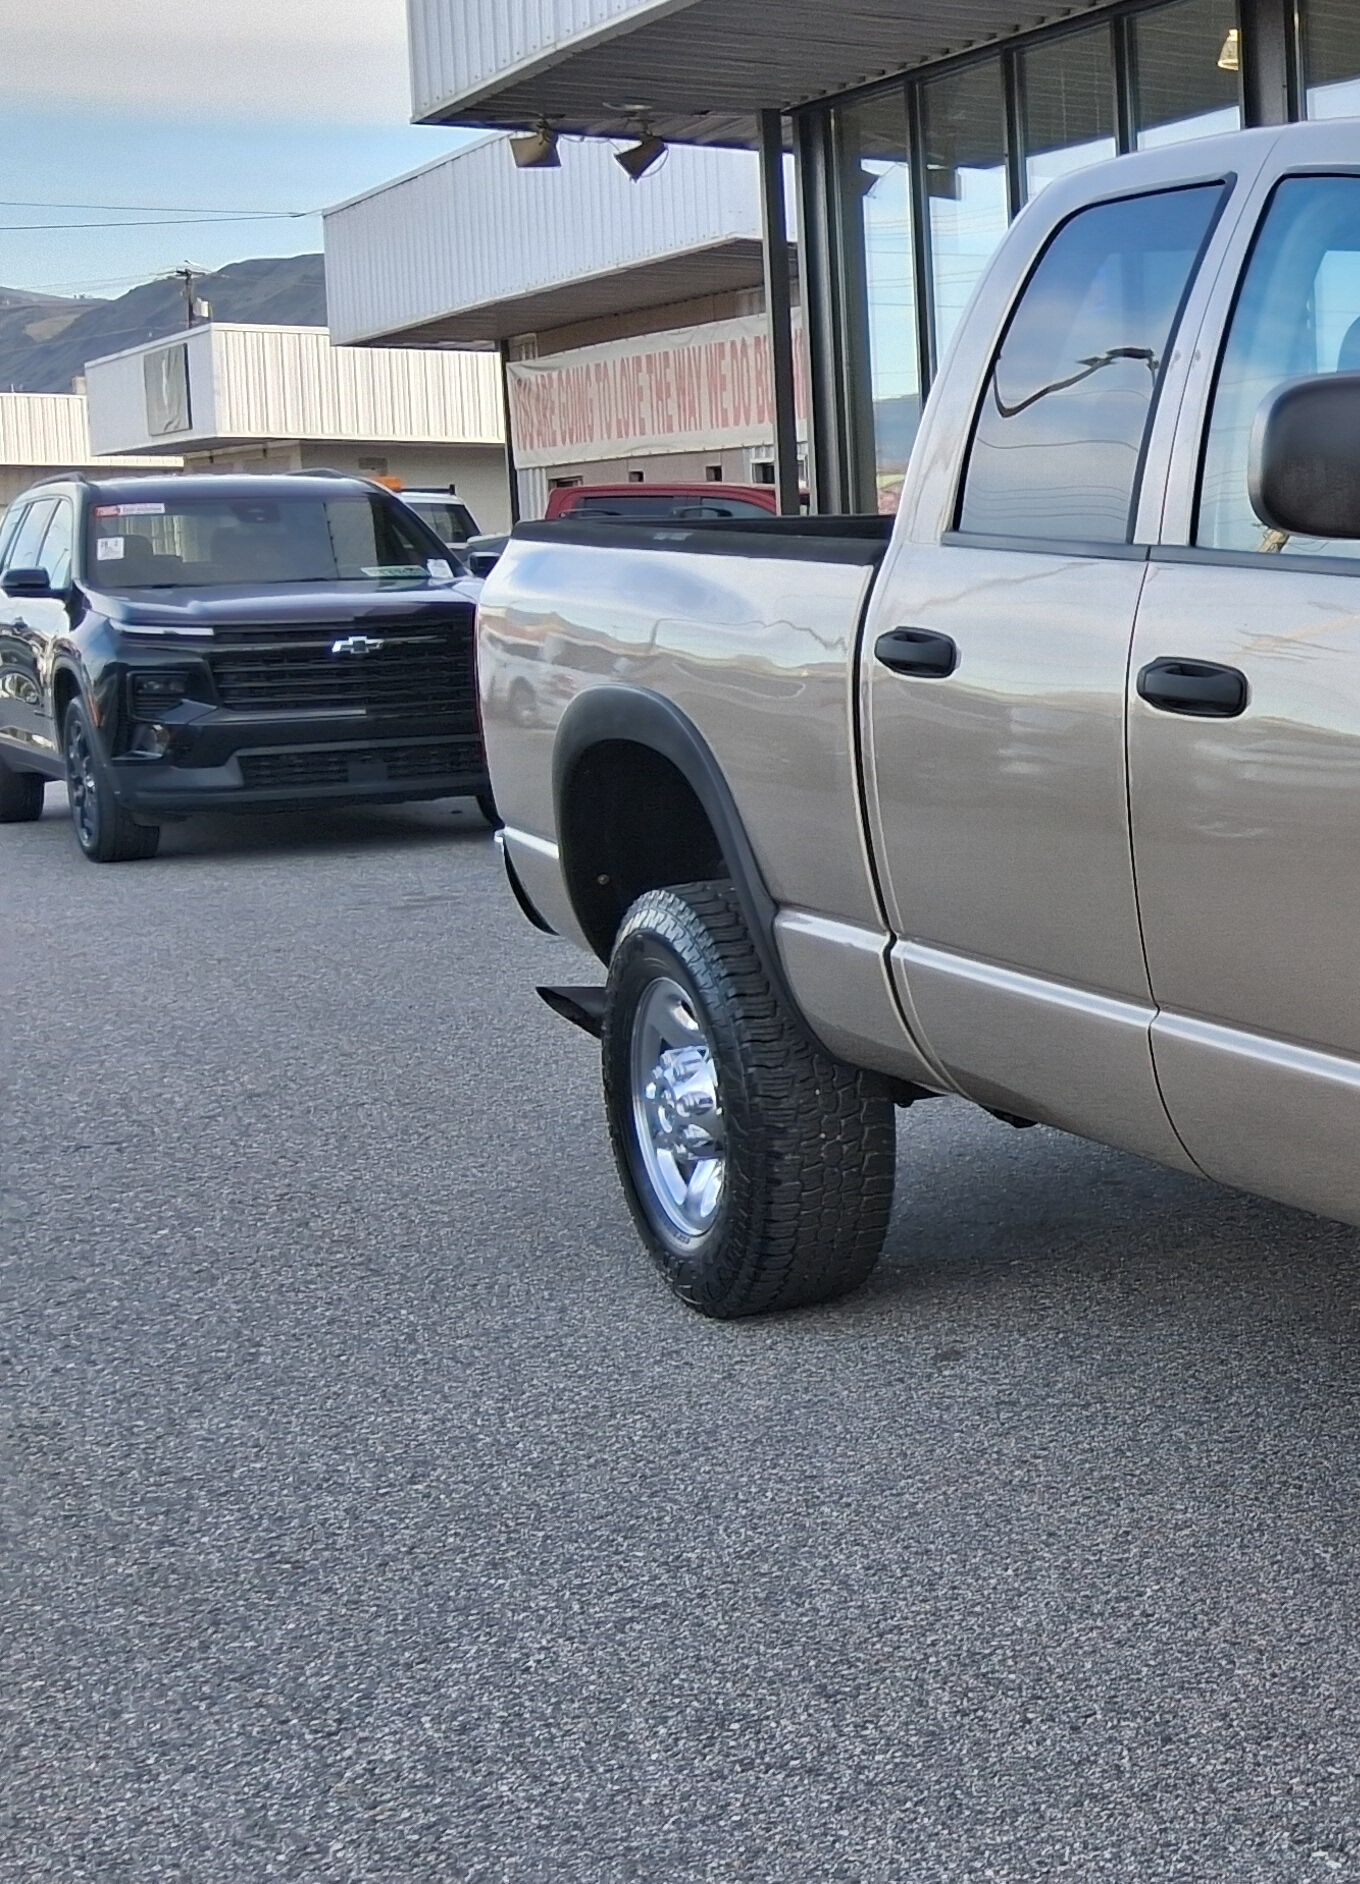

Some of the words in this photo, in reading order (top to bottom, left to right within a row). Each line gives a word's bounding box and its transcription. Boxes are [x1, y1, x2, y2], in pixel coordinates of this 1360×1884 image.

[535, 371, 557, 448] ARE
[558, 362, 594, 445] GOING
[594, 360, 611, 440] TO
[613, 354, 646, 438] LOVE
[645, 350, 673, 435] THE
[673, 344, 702, 432] WAY
[705, 341, 729, 430] WE
[730, 336, 750, 427] DO
